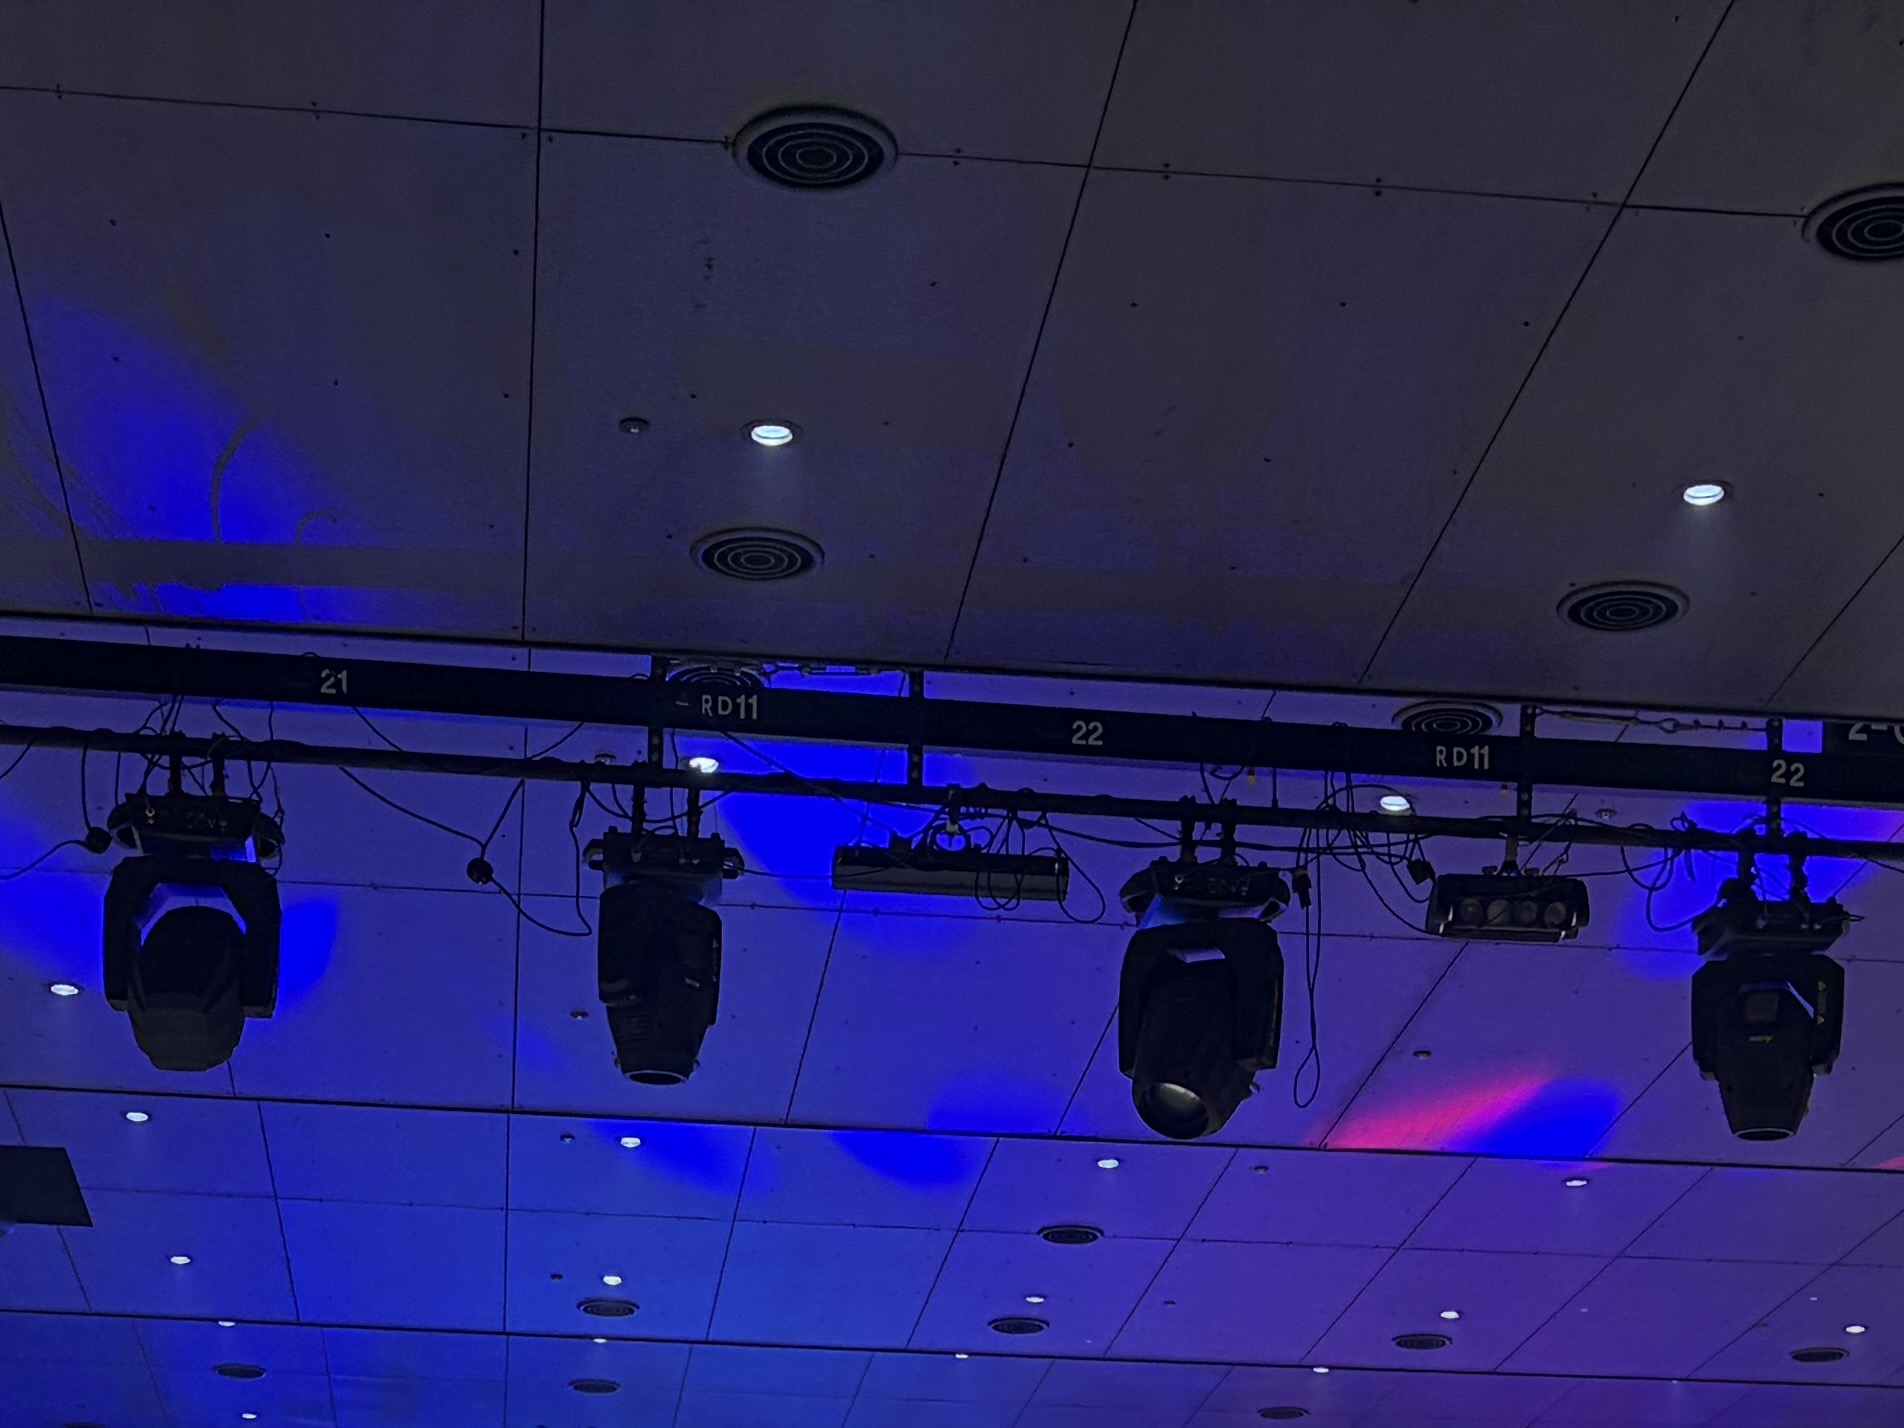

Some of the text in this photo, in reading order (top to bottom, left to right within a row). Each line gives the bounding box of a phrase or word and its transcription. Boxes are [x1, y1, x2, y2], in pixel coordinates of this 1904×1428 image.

[320, 668, 349, 695] 21
[1071, 720, 1104, 747] 22
[1770, 759, 1806, 788] 22
